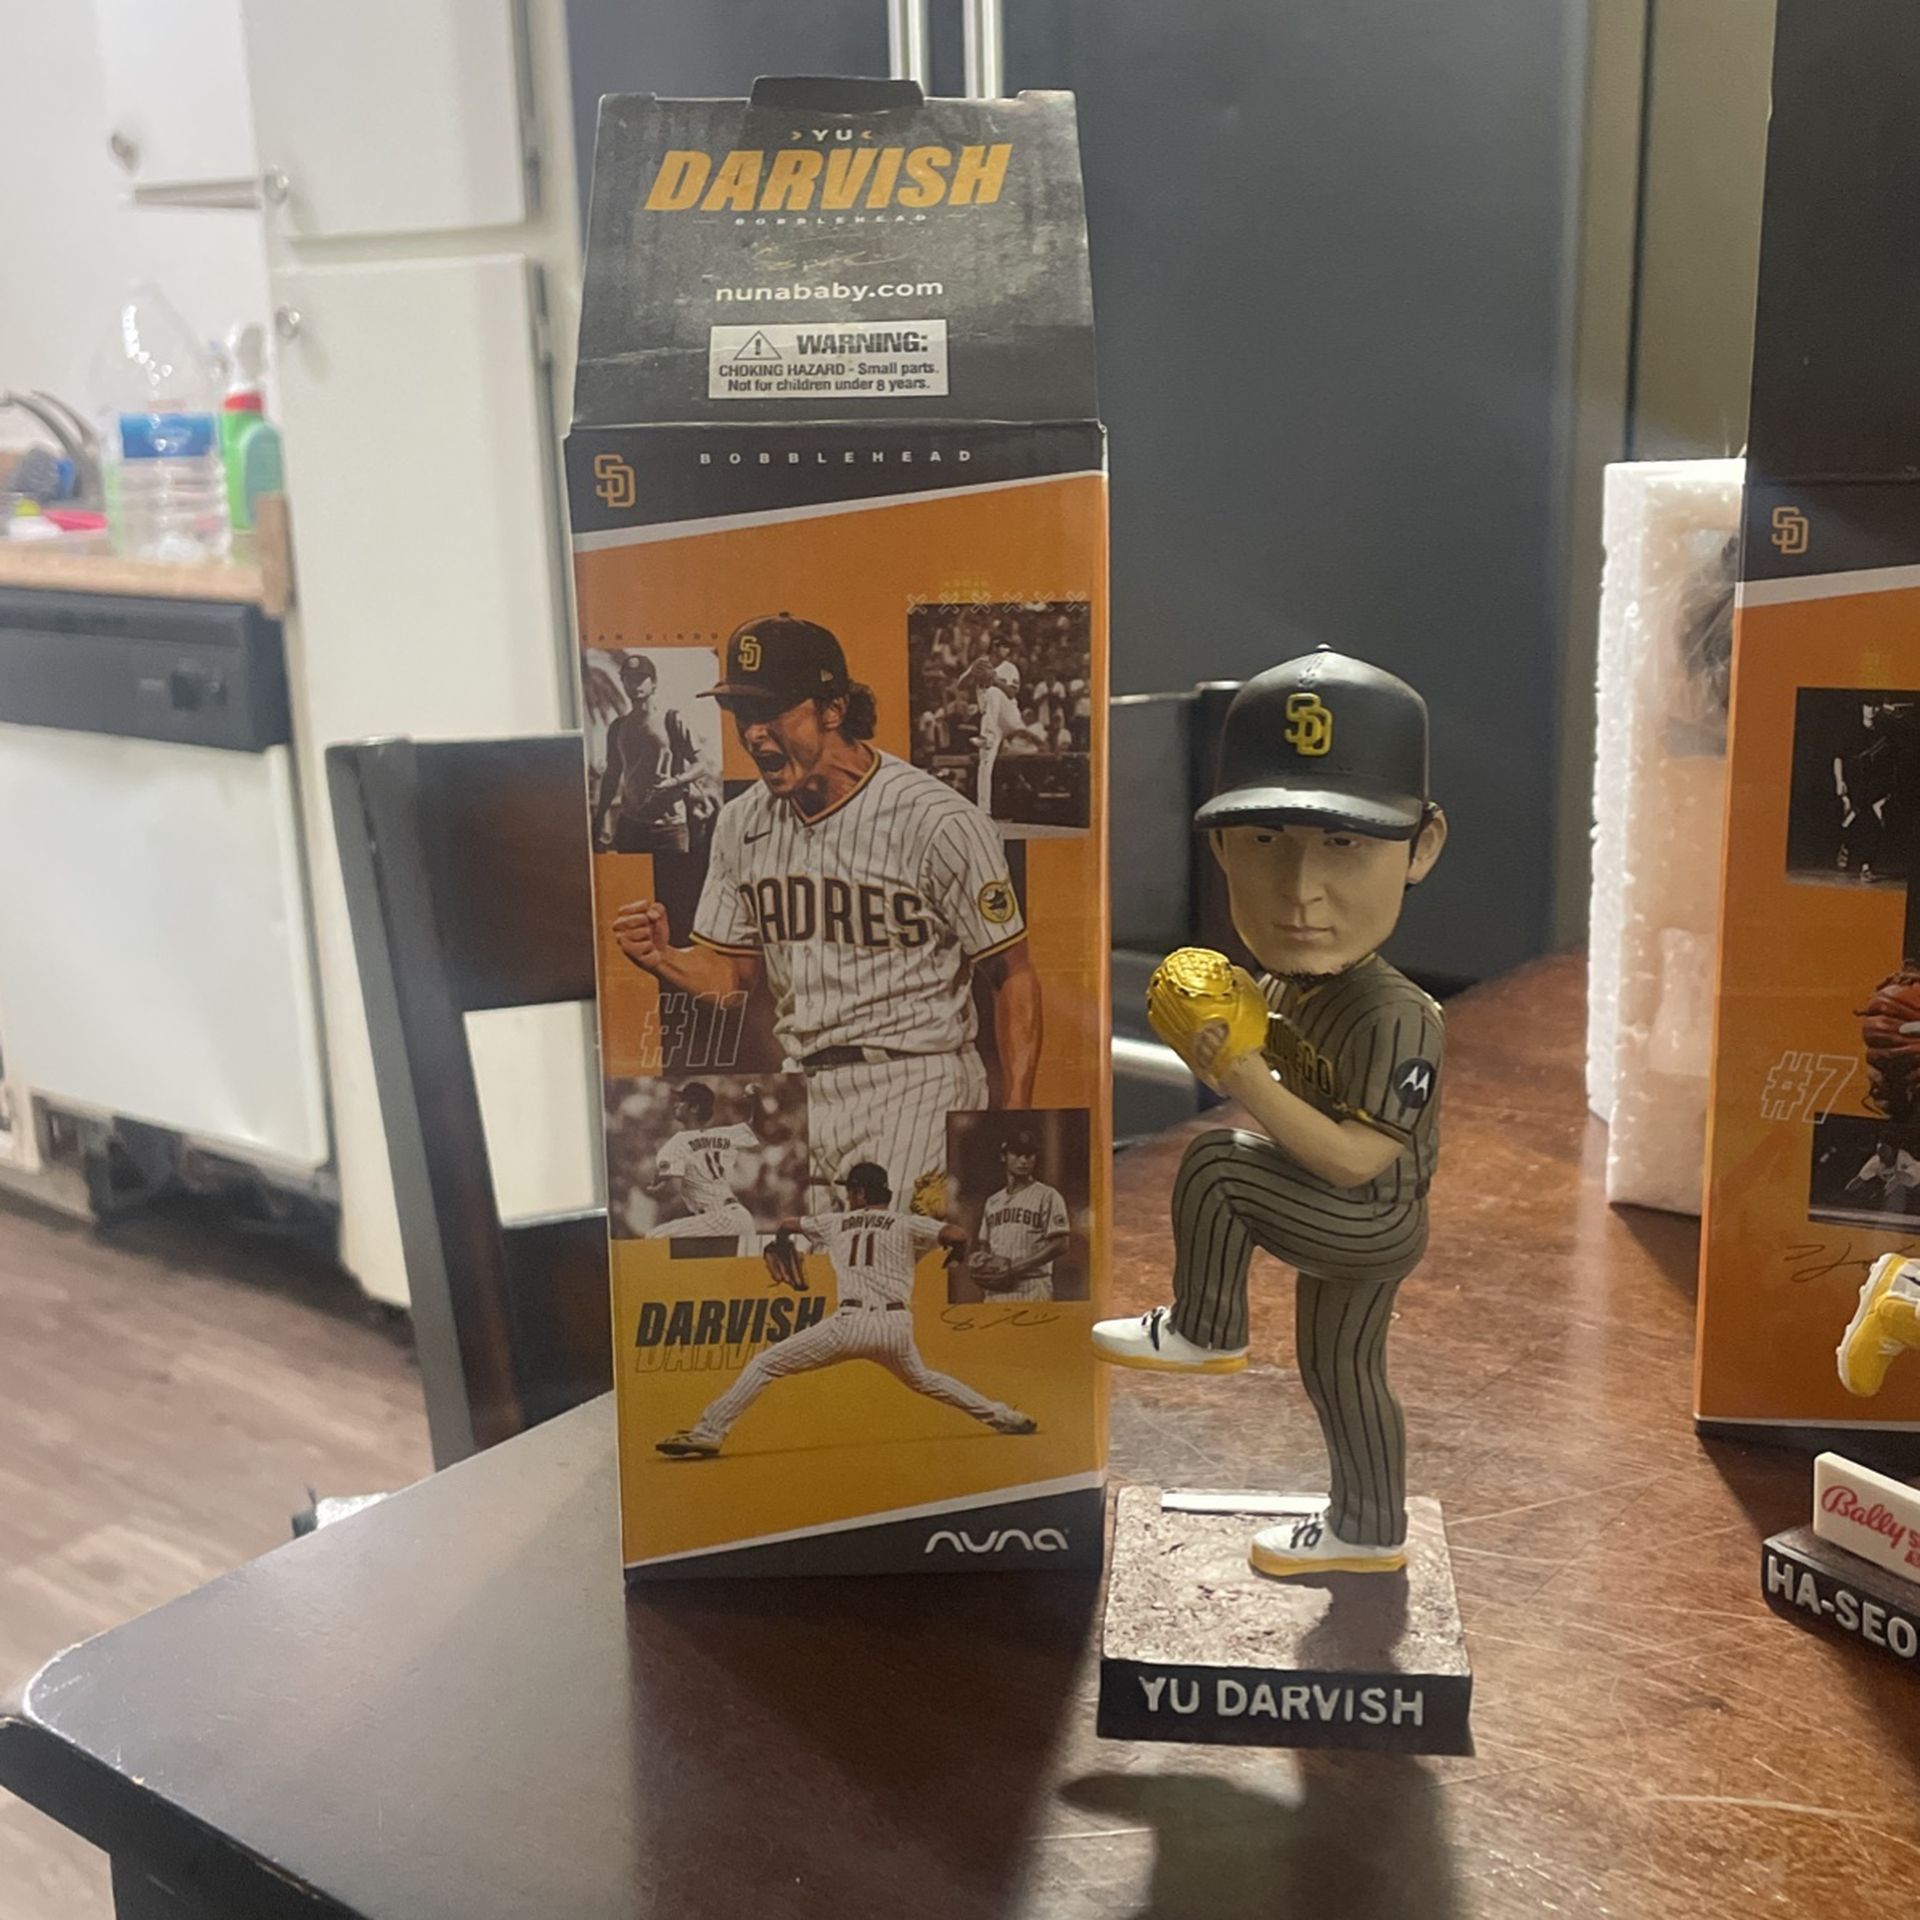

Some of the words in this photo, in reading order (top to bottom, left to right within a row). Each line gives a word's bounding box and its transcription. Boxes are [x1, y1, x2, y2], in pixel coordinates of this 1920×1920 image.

[812, 129, 853, 141] YU
[644, 143, 1012, 211] DARVISH
[715, 281, 944, 303] nunababy.com
[796, 331, 929, 355] WARNING:
[718, 364, 783, 377] CHOKING
[787, 363, 846, 376] HAZARD
[857, 361, 898, 375] Small
[901, 361, 939, 378] parts.
[727, 379, 751, 392] Not
[754, 378, 772, 391] for
[775, 377, 833, 392] children
[835, 376, 873, 390] under
[876, 379, 886, 391] 8
[889, 377, 931, 394] years.
[594, 454, 636, 508] SD
[700, 450, 971, 465] BOBBLEHEAD
[1771, 506, 1808, 554] SD
[1284, 692, 1333, 755] SD
[1760, 1050, 1859, 1125] #7
[848, 1232, 875, 1267] 11
[635, 1296, 826, 1347] DARVISH
[1820, 1485, 1906, 1549] Bally
[1767, 1555, 1918, 1658] HA-SEO
[1139, 1676, 1199, 1713] YU
[1217, 1679, 1423, 1726] DARVISH
